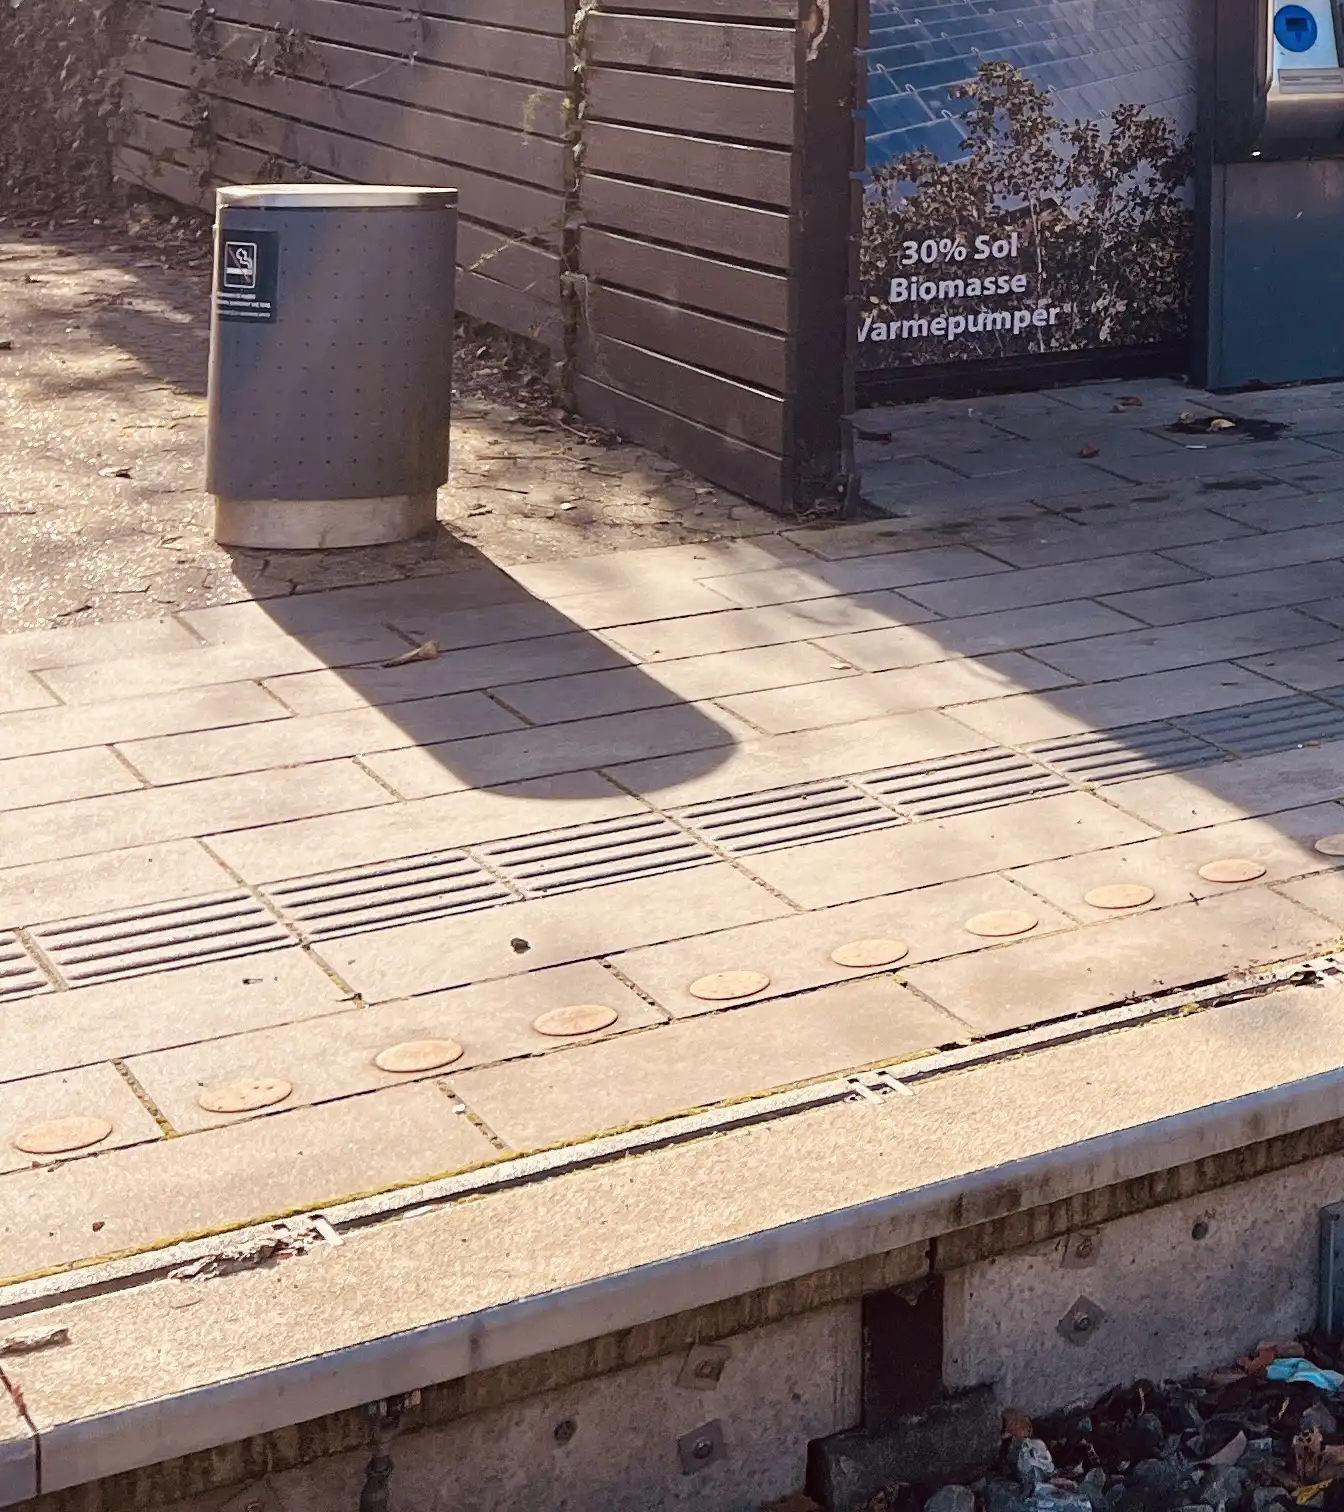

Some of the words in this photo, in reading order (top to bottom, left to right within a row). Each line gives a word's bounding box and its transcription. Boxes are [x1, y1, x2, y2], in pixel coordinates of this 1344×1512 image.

[901, 237, 967, 266] 30%
[973, 231, 1018, 260] Sol
[889, 273, 1027, 303] Biomasse
